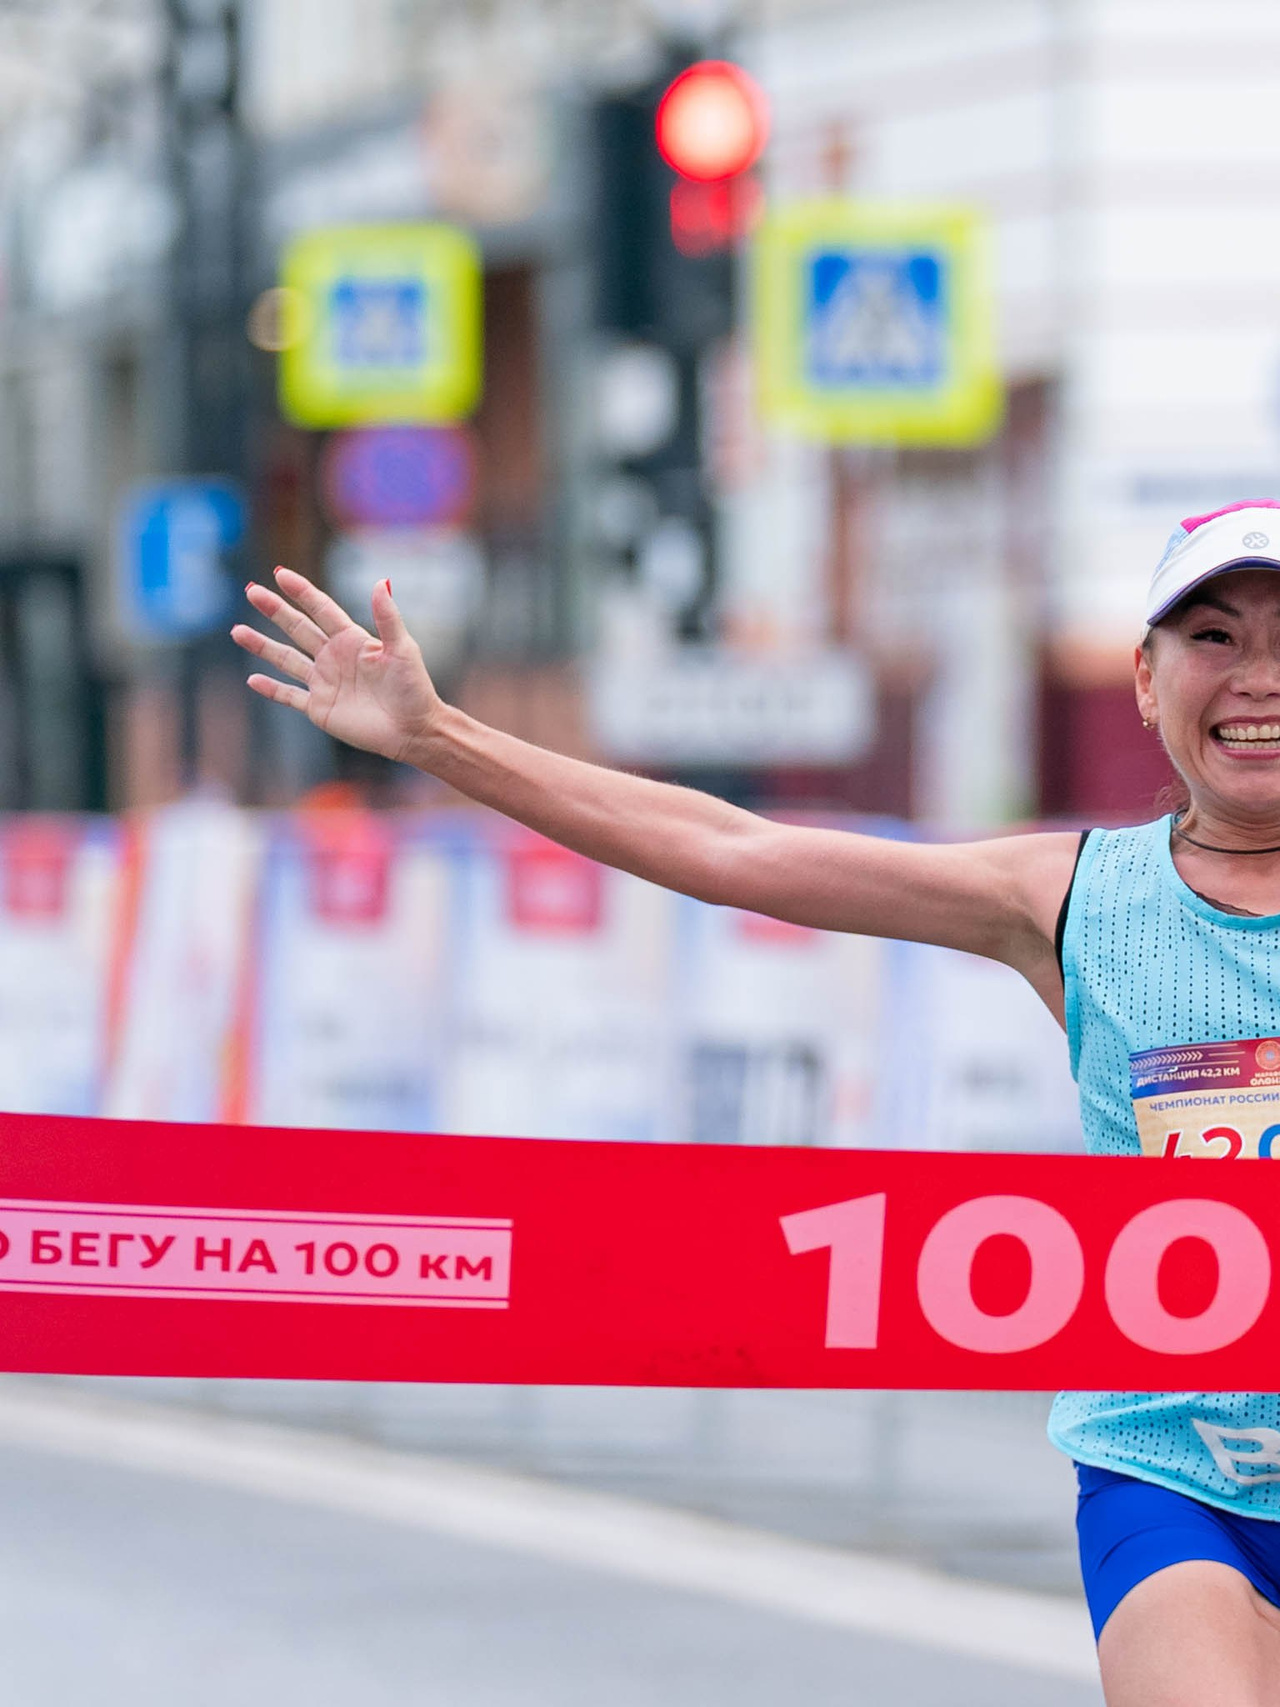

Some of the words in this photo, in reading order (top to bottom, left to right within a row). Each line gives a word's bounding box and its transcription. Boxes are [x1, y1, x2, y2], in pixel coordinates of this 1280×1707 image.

[1136, 1069, 1199, 1088] ДИСТАНЦИЯ
[1200, 1068, 1222, 1079] 42,2
[1223, 1067, 1240, 1076] КМ
[1149, 1095, 1226, 1112] ЧЕМПИОНАТ
[1229, 1092, 1280, 1105] РОССИИ
[30, 1229, 177, 1269] БЕГУ
[194, 1236, 278, 1275] НА
[295, 1241, 400, 1279] 100
[779, 1192, 1271, 1354] 100
